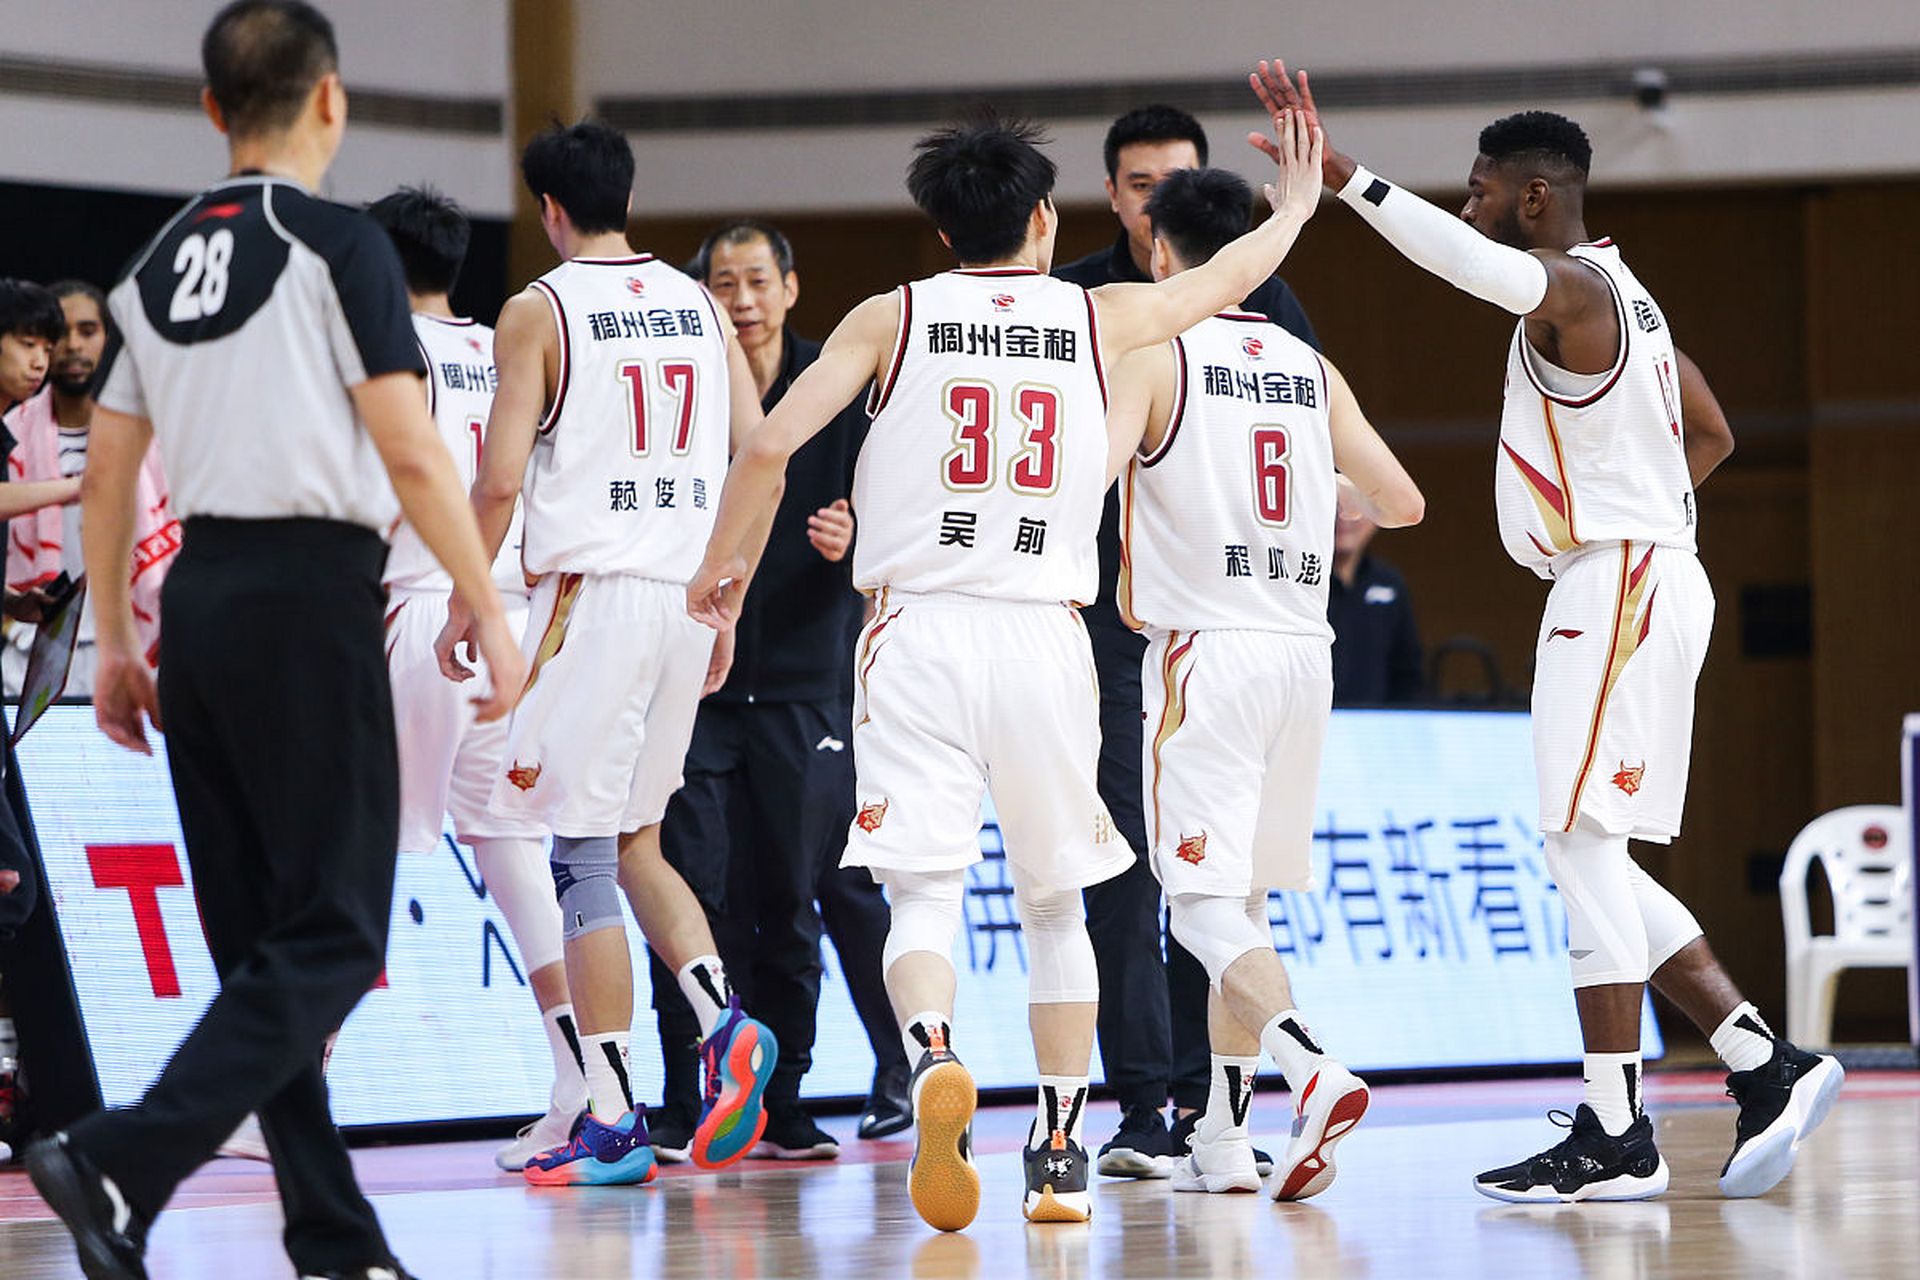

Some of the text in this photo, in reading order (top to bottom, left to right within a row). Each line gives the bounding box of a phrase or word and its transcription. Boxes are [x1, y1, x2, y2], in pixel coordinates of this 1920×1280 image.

[168, 229, 234, 322] 28
[588, 309, 704, 341] 稠州金租
[928, 322, 1076, 363] 稠州金租
[619, 360, 697, 454] 17
[1203, 364, 1317, 409] 稠州金租
[942, 379, 1062, 496] 33
[1251, 425, 1291, 527] 6
